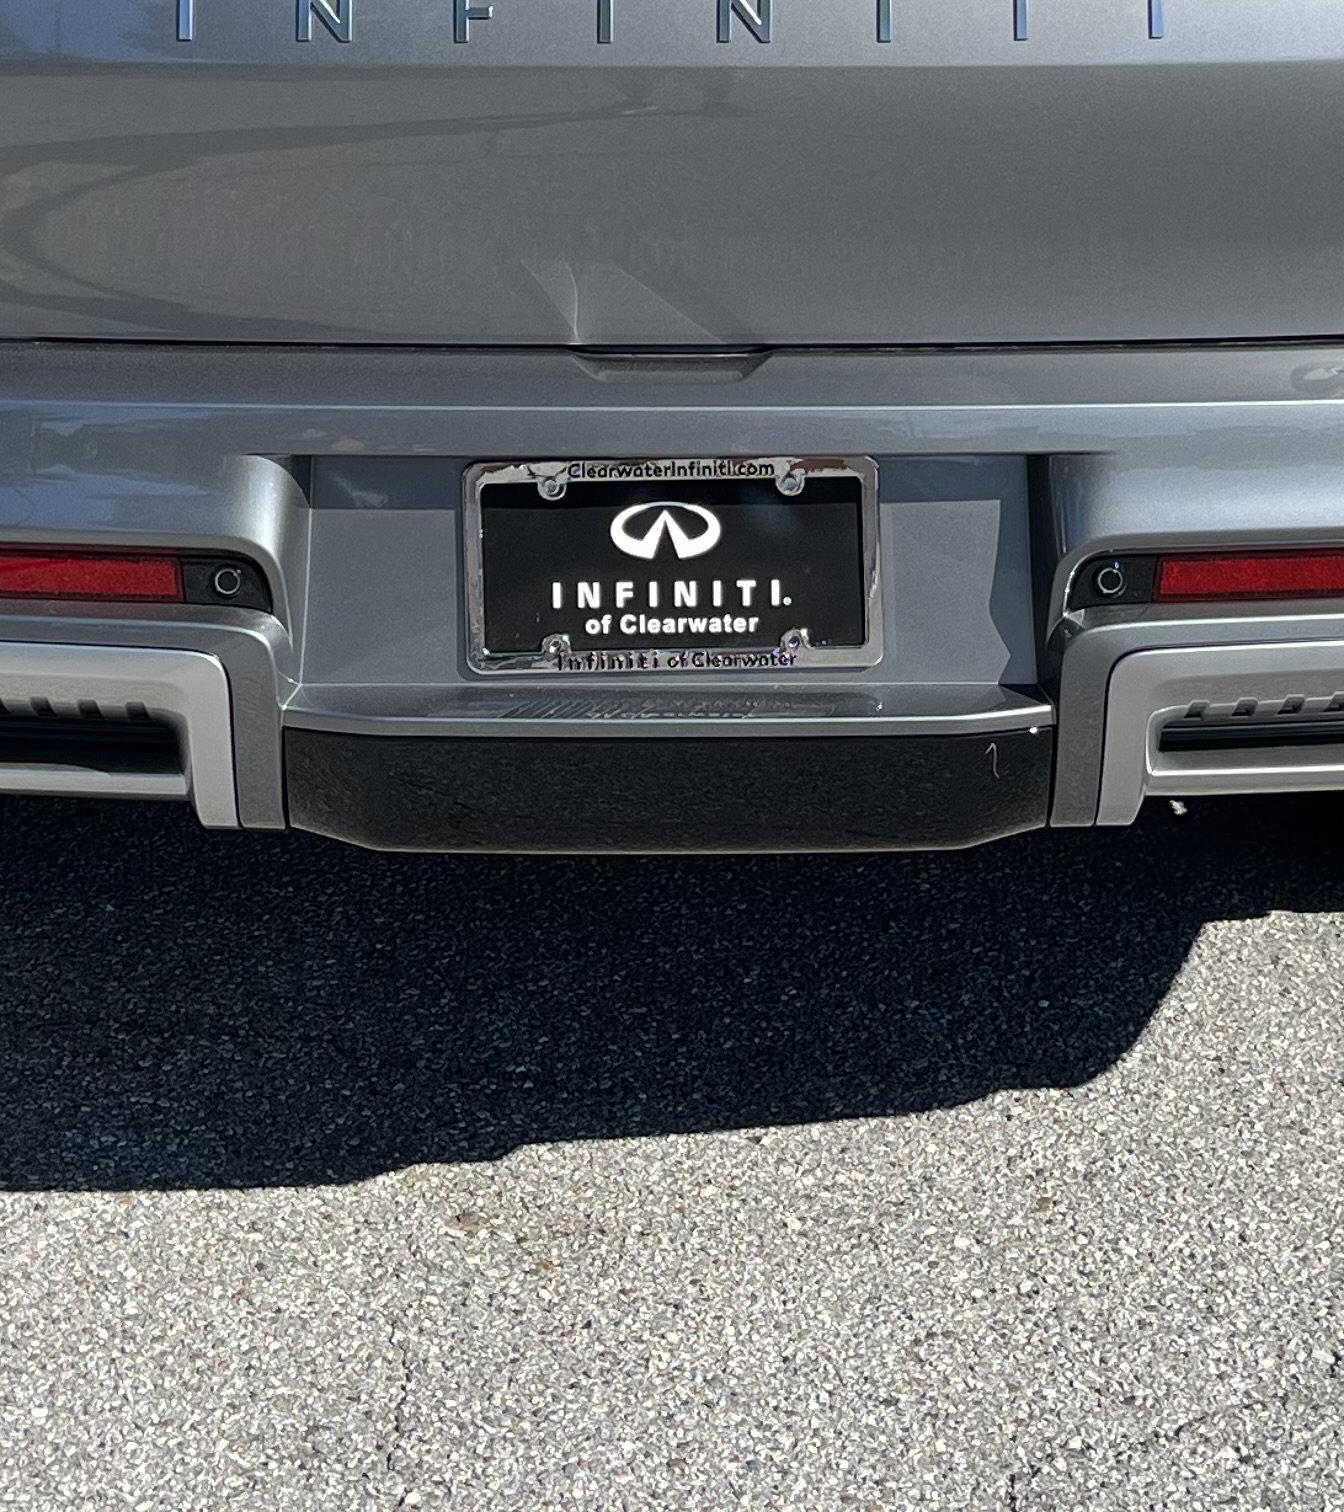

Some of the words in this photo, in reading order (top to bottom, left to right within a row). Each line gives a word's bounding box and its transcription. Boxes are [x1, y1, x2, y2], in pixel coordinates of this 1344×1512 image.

[585, 614, 612, 635] of
[619, 613, 760, 635] Clearwater
[557, 650, 661, 671] Infiniti
[667, 650, 688, 669] of
[692, 650, 797, 670] Clearwater
